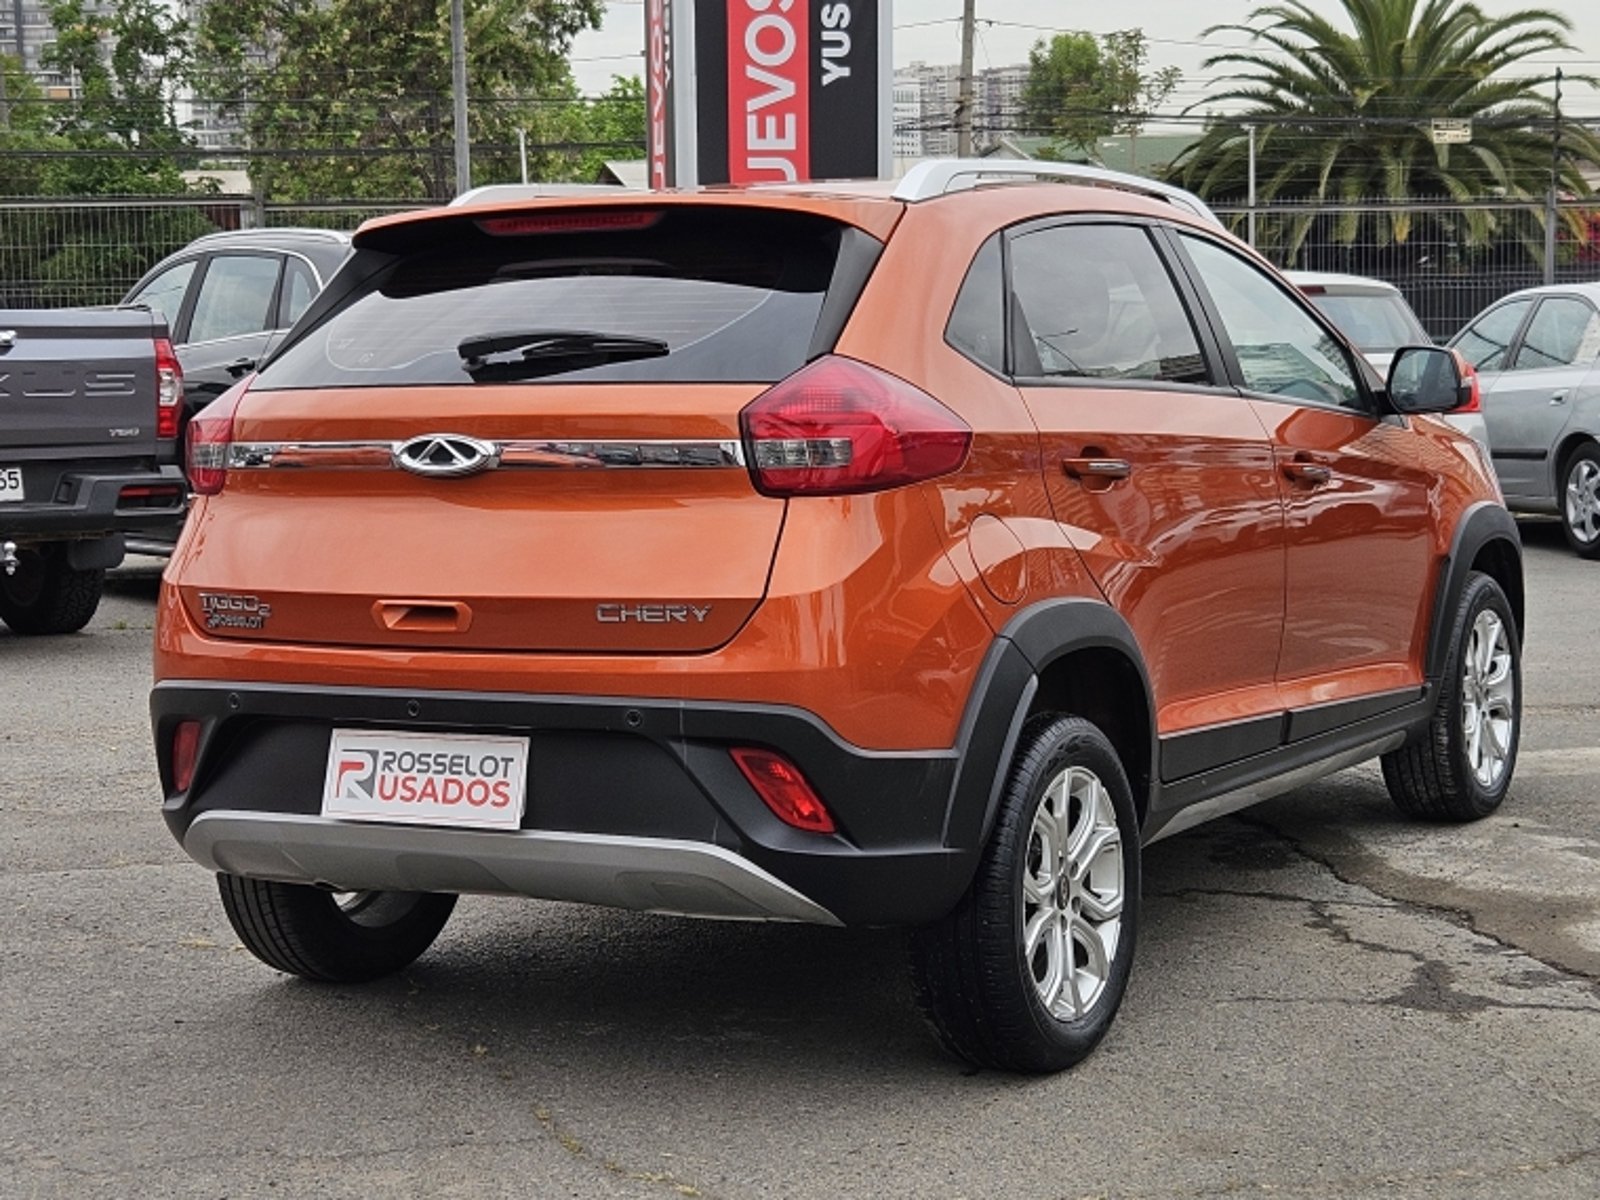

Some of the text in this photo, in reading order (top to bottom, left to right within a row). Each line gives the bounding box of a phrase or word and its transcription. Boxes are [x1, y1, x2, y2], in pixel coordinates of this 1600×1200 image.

[596, 603, 712, 622] CHERY
[382, 751, 515, 779] ROSSELOT
[377, 775, 511, 808] USADOS
